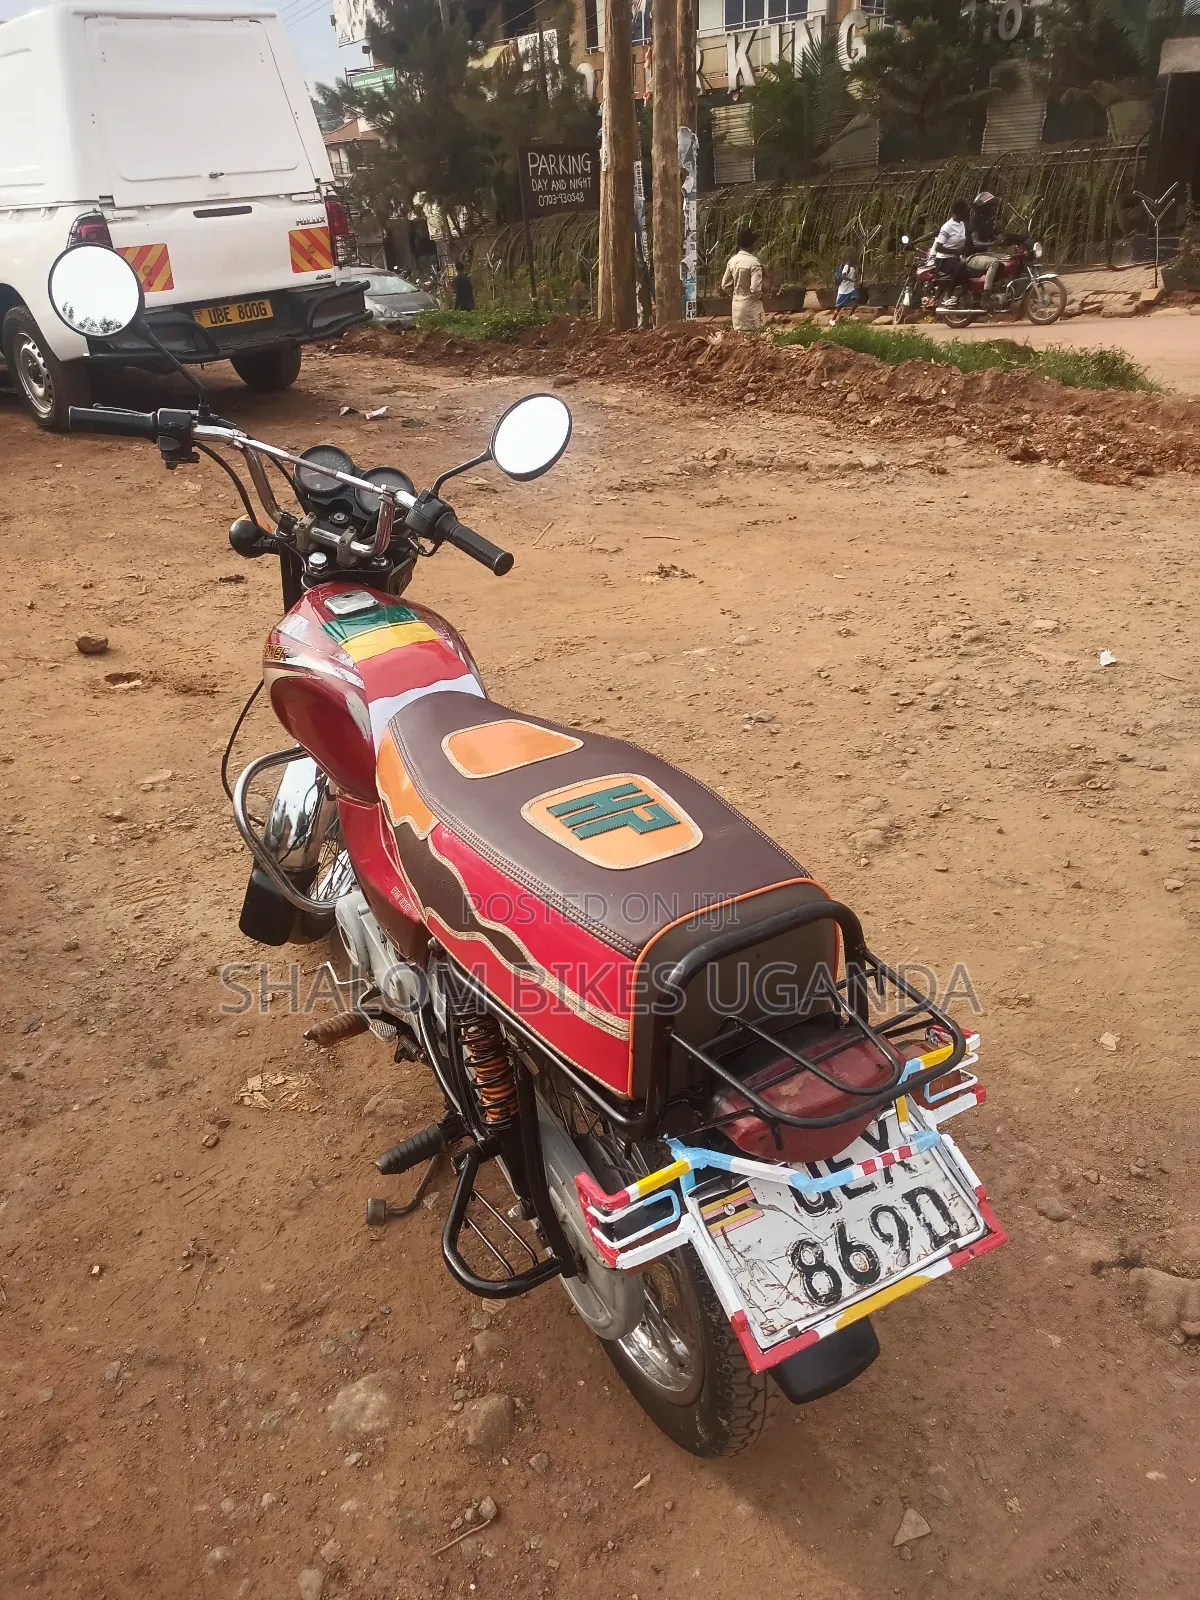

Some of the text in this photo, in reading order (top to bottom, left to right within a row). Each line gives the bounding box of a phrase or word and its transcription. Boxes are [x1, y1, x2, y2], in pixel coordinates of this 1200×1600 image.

[528, 152, 592, 176] PARKING
[531, 177, 592, 192] DAY AND NIGHT
[538, 192, 585, 207] 0703-930548
[208, 301, 268, 325] UBE 800G
[546, 782, 681, 841] HP
[788, 1186, 961, 1307] 869D
